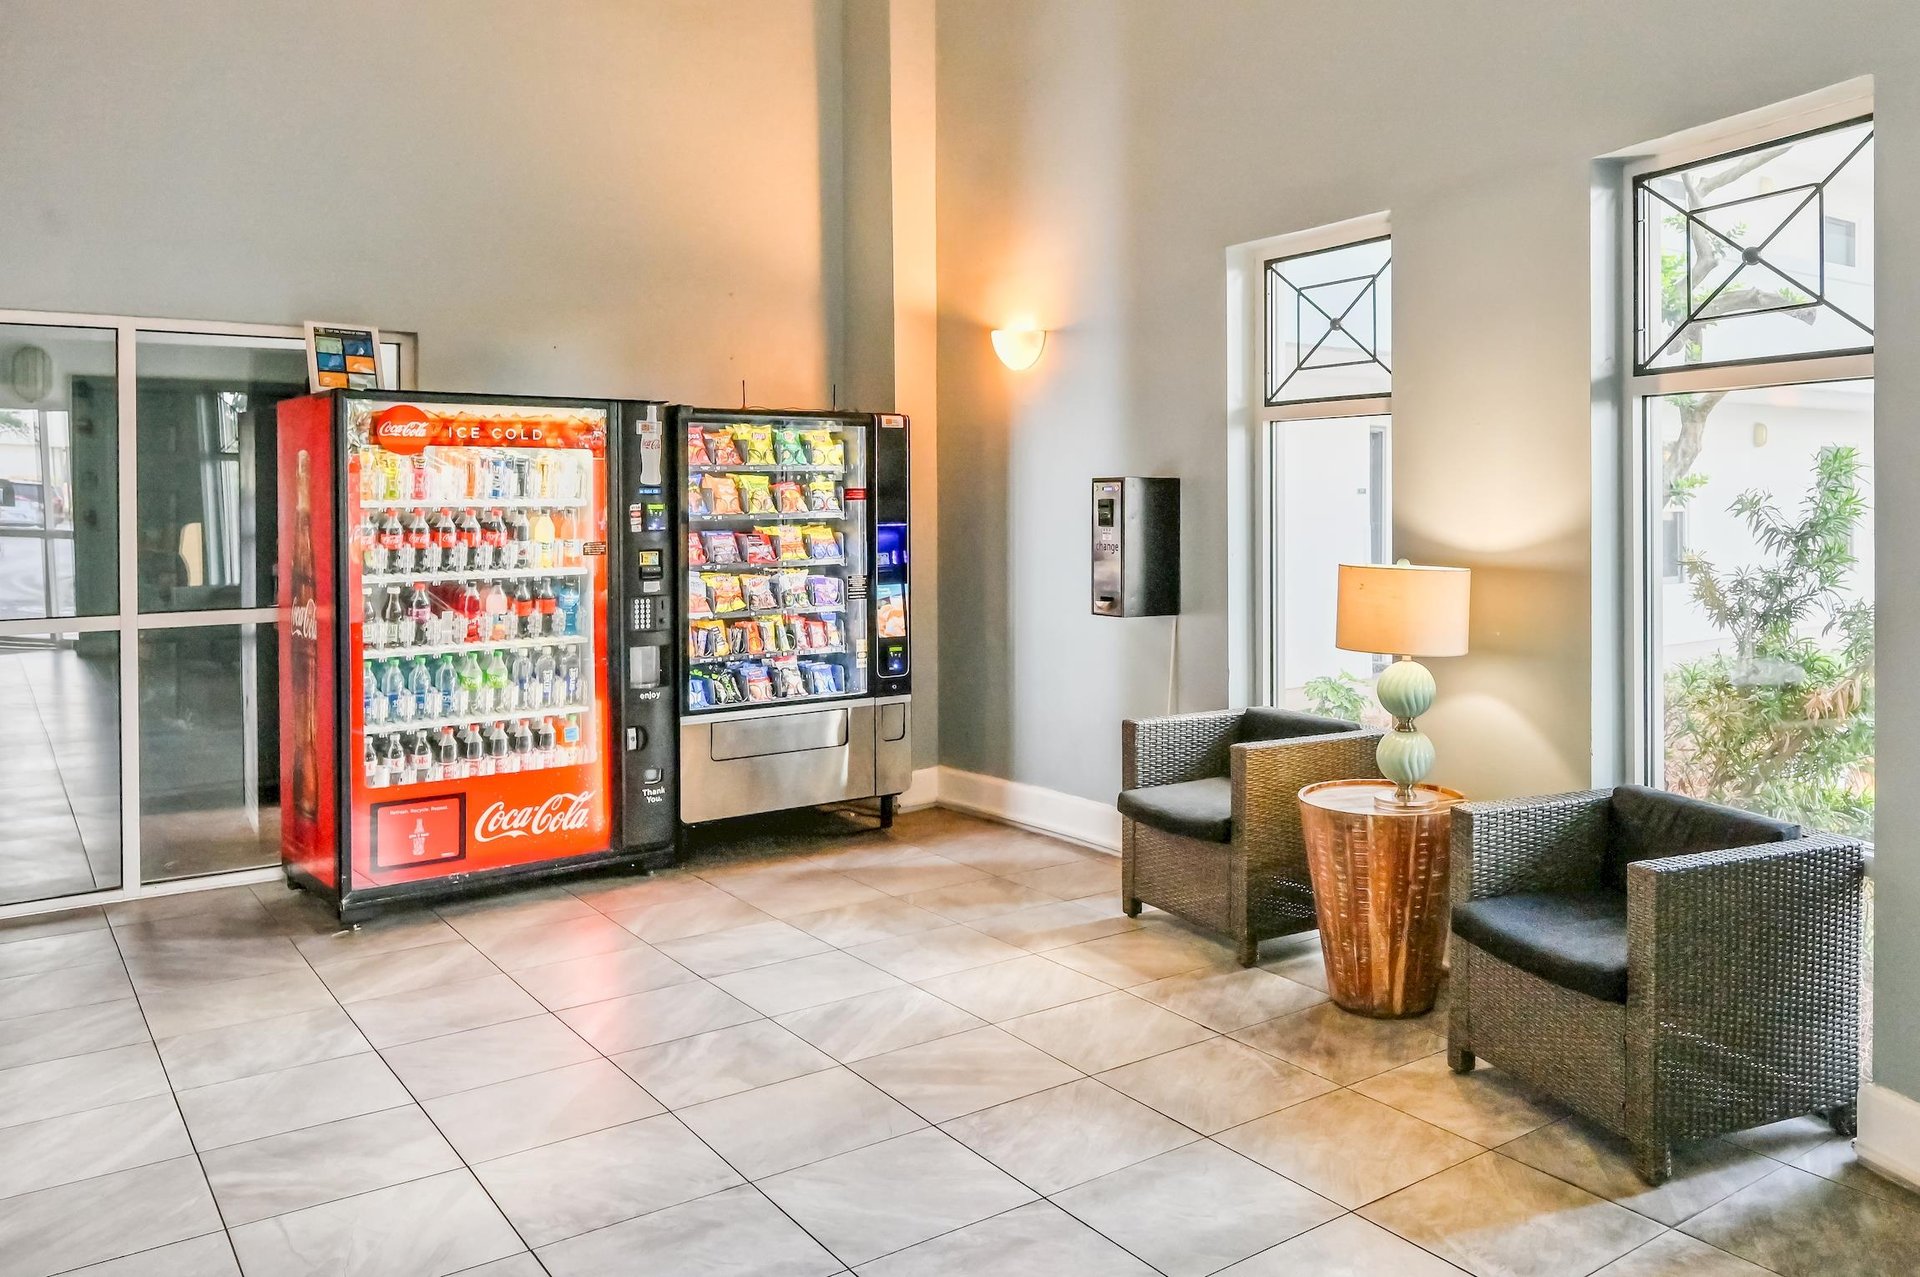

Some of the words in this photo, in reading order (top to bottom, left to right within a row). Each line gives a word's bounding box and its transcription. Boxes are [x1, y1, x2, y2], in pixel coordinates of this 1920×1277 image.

[378, 420, 429, 437] Coca-Cola
[448, 426, 481, 439] ICE
[491, 428, 543, 441] COLD
[1096, 541, 1119, 554] change
[640, 691, 661, 700] enjoy
[641, 786, 666, 797] Thank
[474, 790, 596, 843] Coca-Cola
